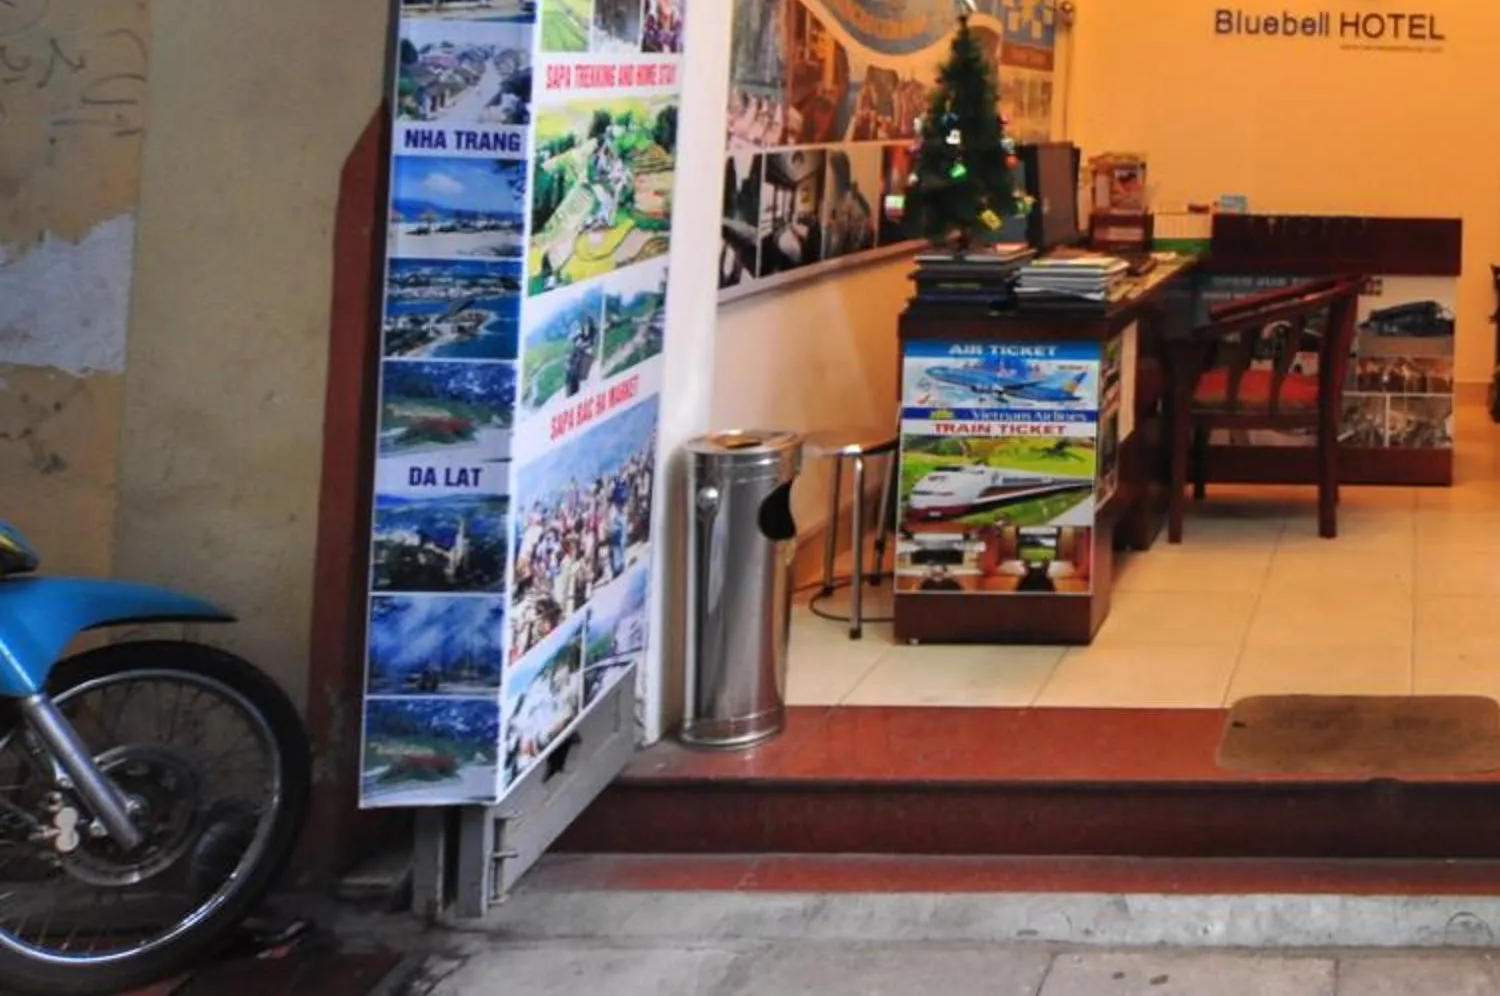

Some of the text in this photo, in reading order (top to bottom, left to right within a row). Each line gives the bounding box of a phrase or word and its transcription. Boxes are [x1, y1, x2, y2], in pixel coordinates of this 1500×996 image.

[1214, 9, 1445, 41] Bluebell HOTEL
[404, 129, 521, 152] NHA TRANG
[950, 344, 1058, 357] AIR TICKET
[970, 409, 1088, 422] Vietnam Airlines
[934, 423, 1067, 435] TRAIN TICKET
[408, 466, 483, 488] DA LAT
